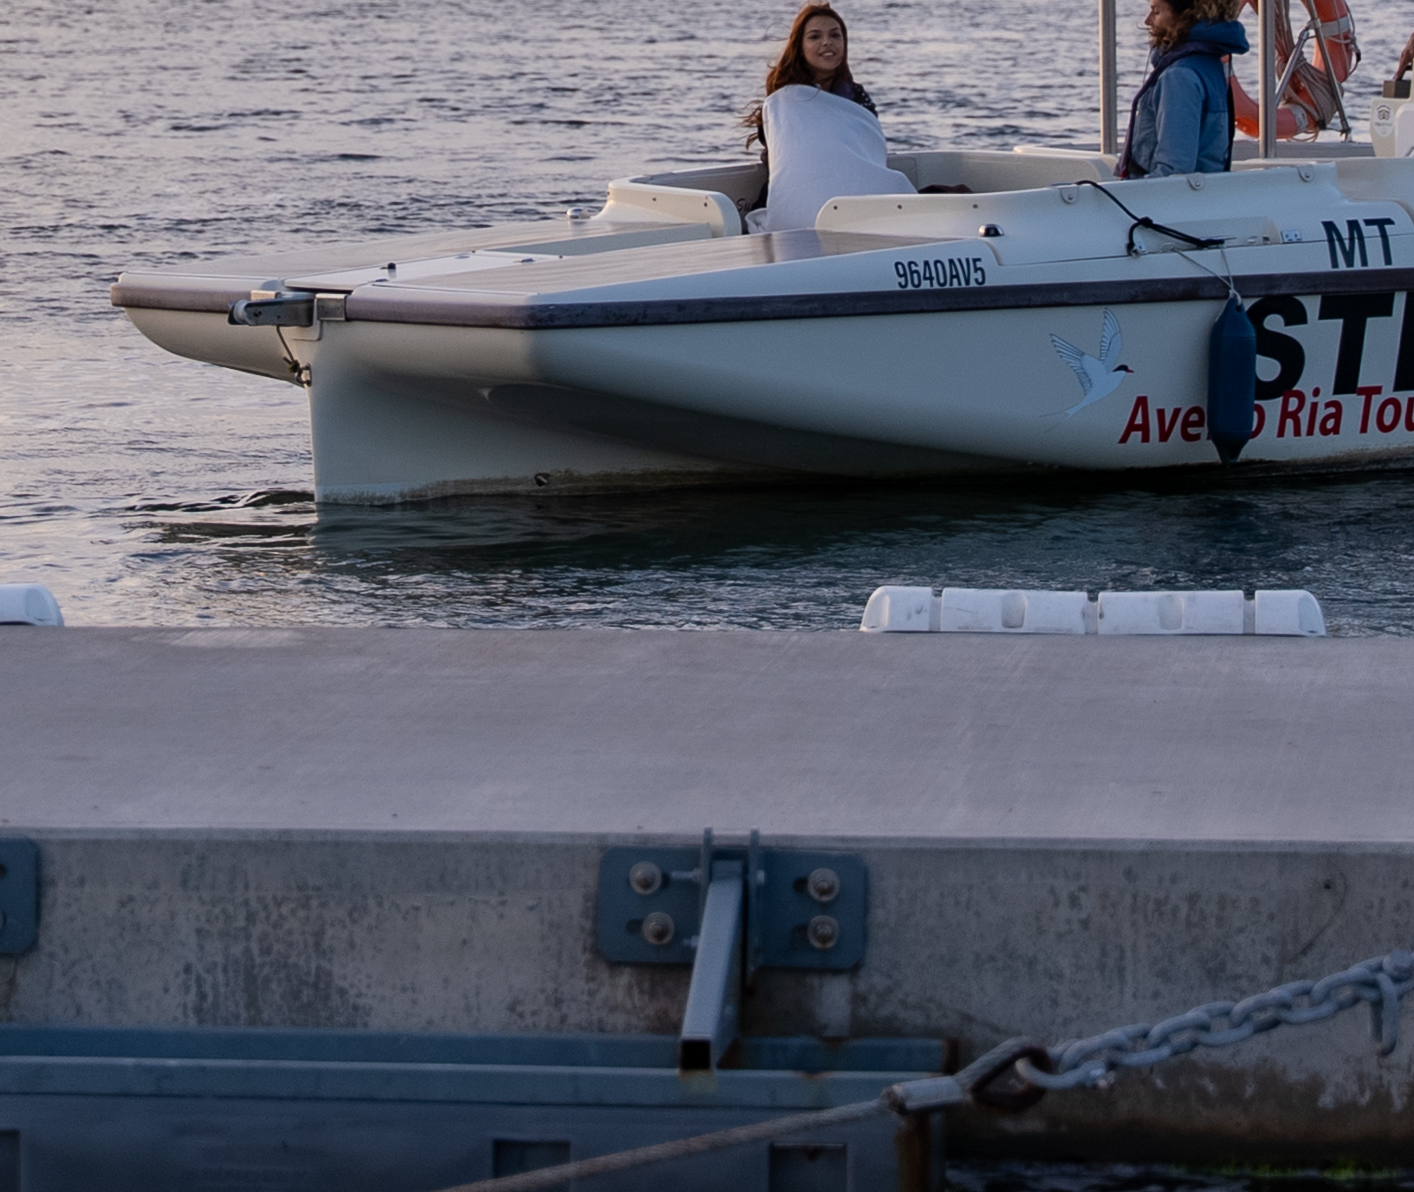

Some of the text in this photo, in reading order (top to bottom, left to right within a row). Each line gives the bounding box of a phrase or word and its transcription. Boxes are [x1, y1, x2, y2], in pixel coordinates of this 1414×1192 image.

[1321, 217, 1395, 269] MT
[894, 257, 986, 289] 9640AV5
[1117, 395, 1266, 444] Aveo
[1276, 386, 1344, 439] Ria
